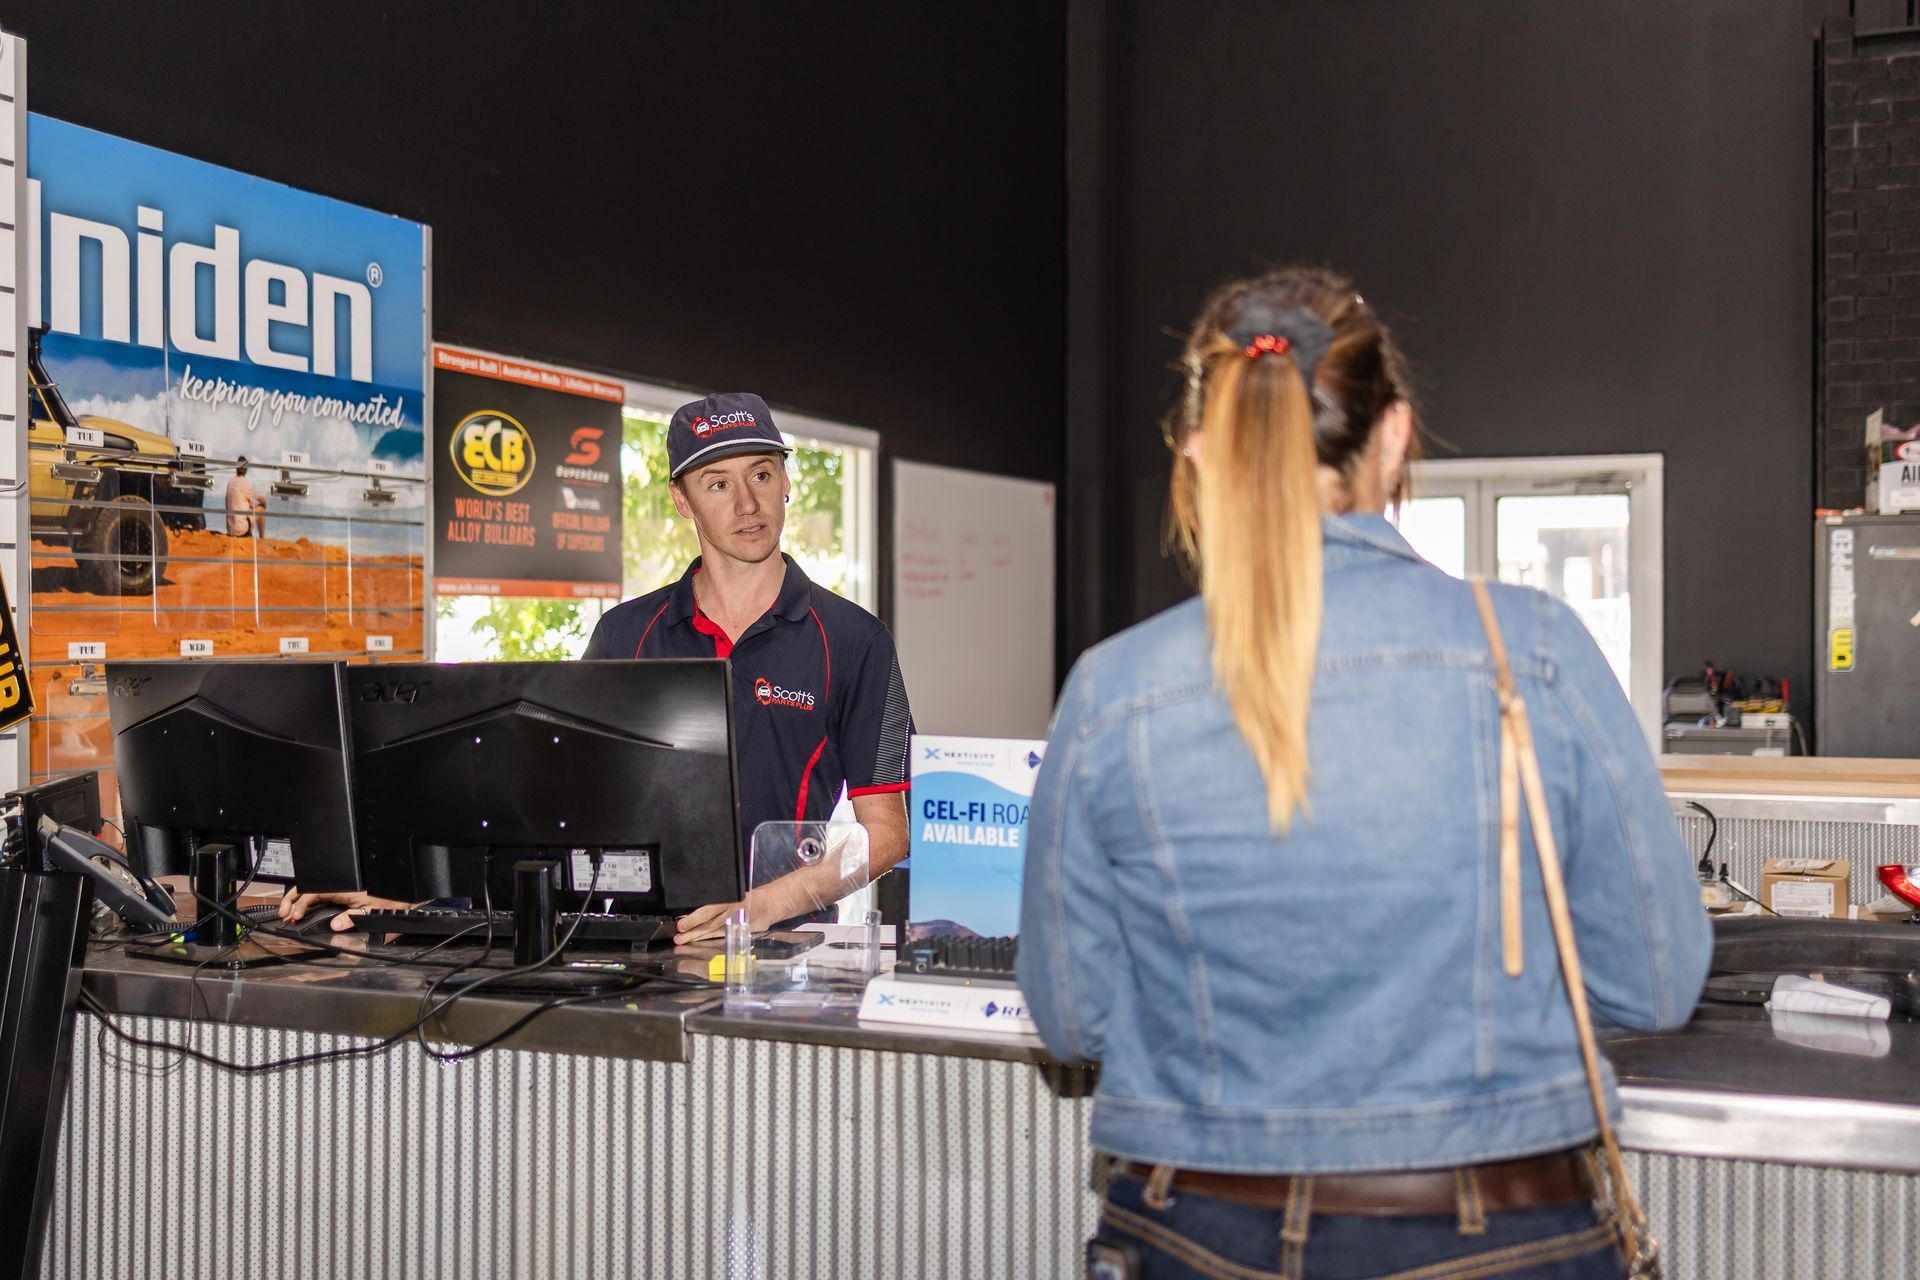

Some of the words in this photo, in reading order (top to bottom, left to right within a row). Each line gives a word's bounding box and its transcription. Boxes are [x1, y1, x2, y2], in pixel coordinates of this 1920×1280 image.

[27, 178, 373, 383] niden
[438, 351, 478, 370] Strongest
[180, 364, 267, 431] keeping
[270, 389, 310, 427] you
[313, 393, 404, 430] connected
[710, 411, 755, 428] Scott's
[77, 431, 94, 441] TUE
[189, 443, 205, 452] WED
[464, 420, 526, 473] ECB
[455, 498, 503, 521] WORLD'S
[505, 502, 530, 523] BEST
[448, 520, 481, 543] ALLOY
[484, 522, 536, 547] BULLBARS
[79, 646, 96, 655] TUE
[189, 643, 205, 652] WED
[361, 680, 432, 704] acer
[773, 686, 815, 706] Scott's
[771, 698, 796, 707] PARTS
[795, 703, 814, 712] PLUS
[944, 752, 996, 760] NEXTIVITY
[923, 800, 986, 823] CEL-FI
[922, 823, 1020, 848] AVAILABLE
[898, 998, 952, 1007] NEXTIVITY
